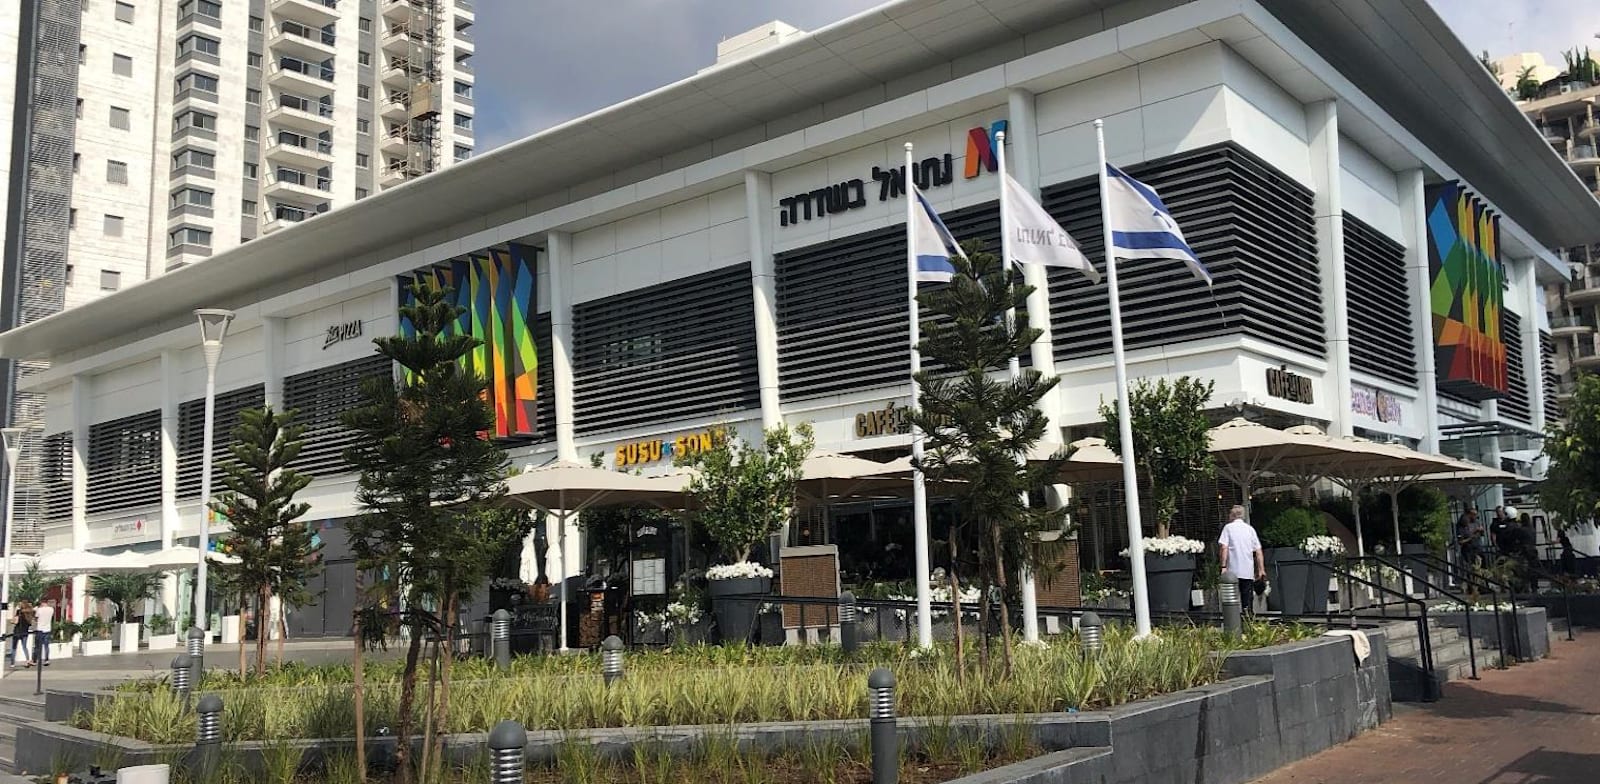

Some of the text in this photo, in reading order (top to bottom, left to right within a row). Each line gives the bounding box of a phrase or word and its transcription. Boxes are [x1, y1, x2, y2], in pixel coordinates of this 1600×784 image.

[779, 178, 866, 227] בשדרה
[855, 401, 896, 438] CAFÉ
[615, 439, 662, 467] SUSU
